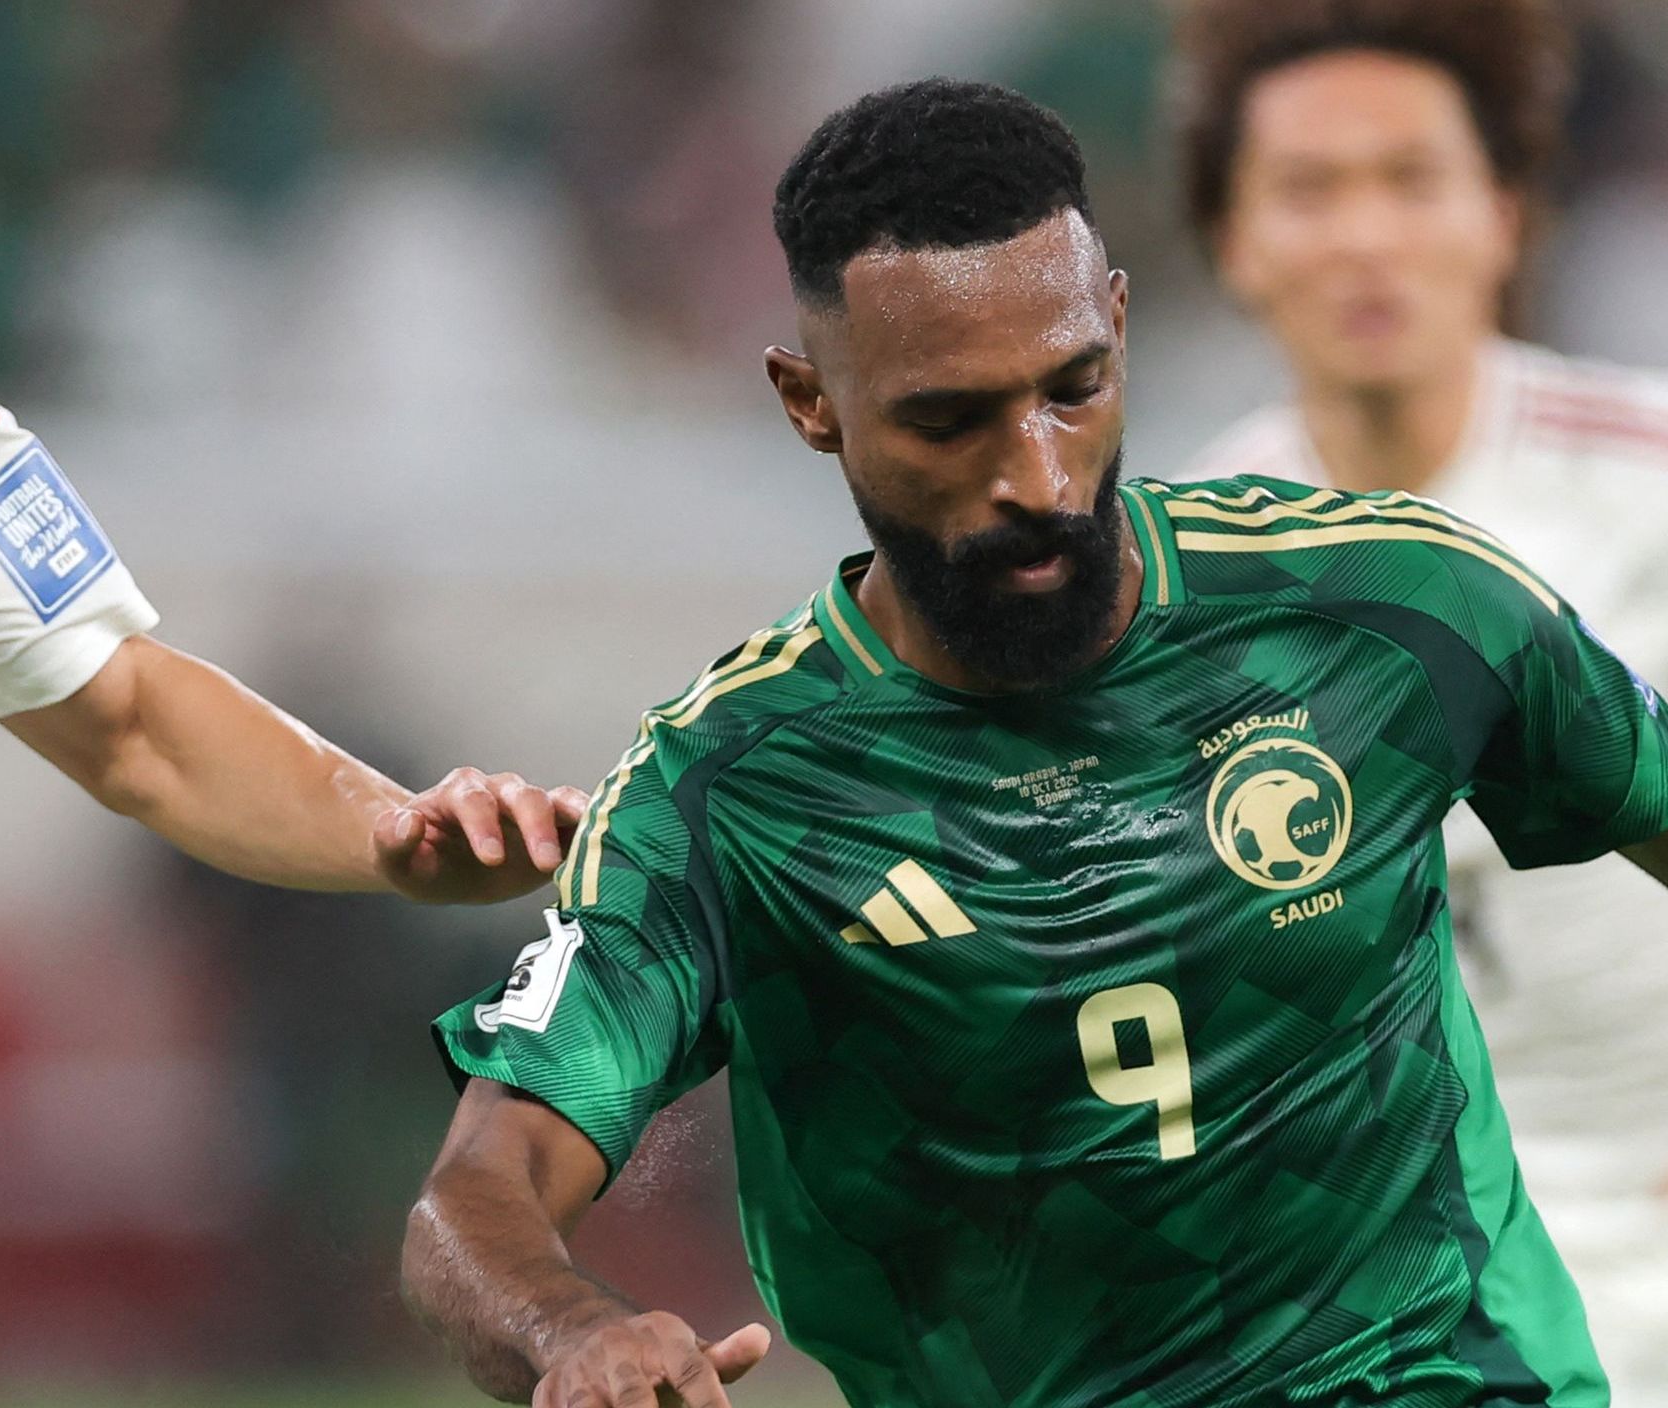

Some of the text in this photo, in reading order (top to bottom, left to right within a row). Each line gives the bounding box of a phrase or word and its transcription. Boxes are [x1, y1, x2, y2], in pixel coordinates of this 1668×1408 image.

[2, 489, 64, 548] UNITES
[1196, 707, 1309, 759] السعودية
[992, 775, 1022, 792] SAUDI
[1022, 766, 1059, 784] ARABIA
[1068, 755, 1100, 773] JAPAN
[1019, 774, 1079, 799] 10 OCT 2024
[1292, 817, 1330, 841] SAFF
[1269, 888, 1344, 930] SAUDI
[1077, 982, 1196, 1161] 9
